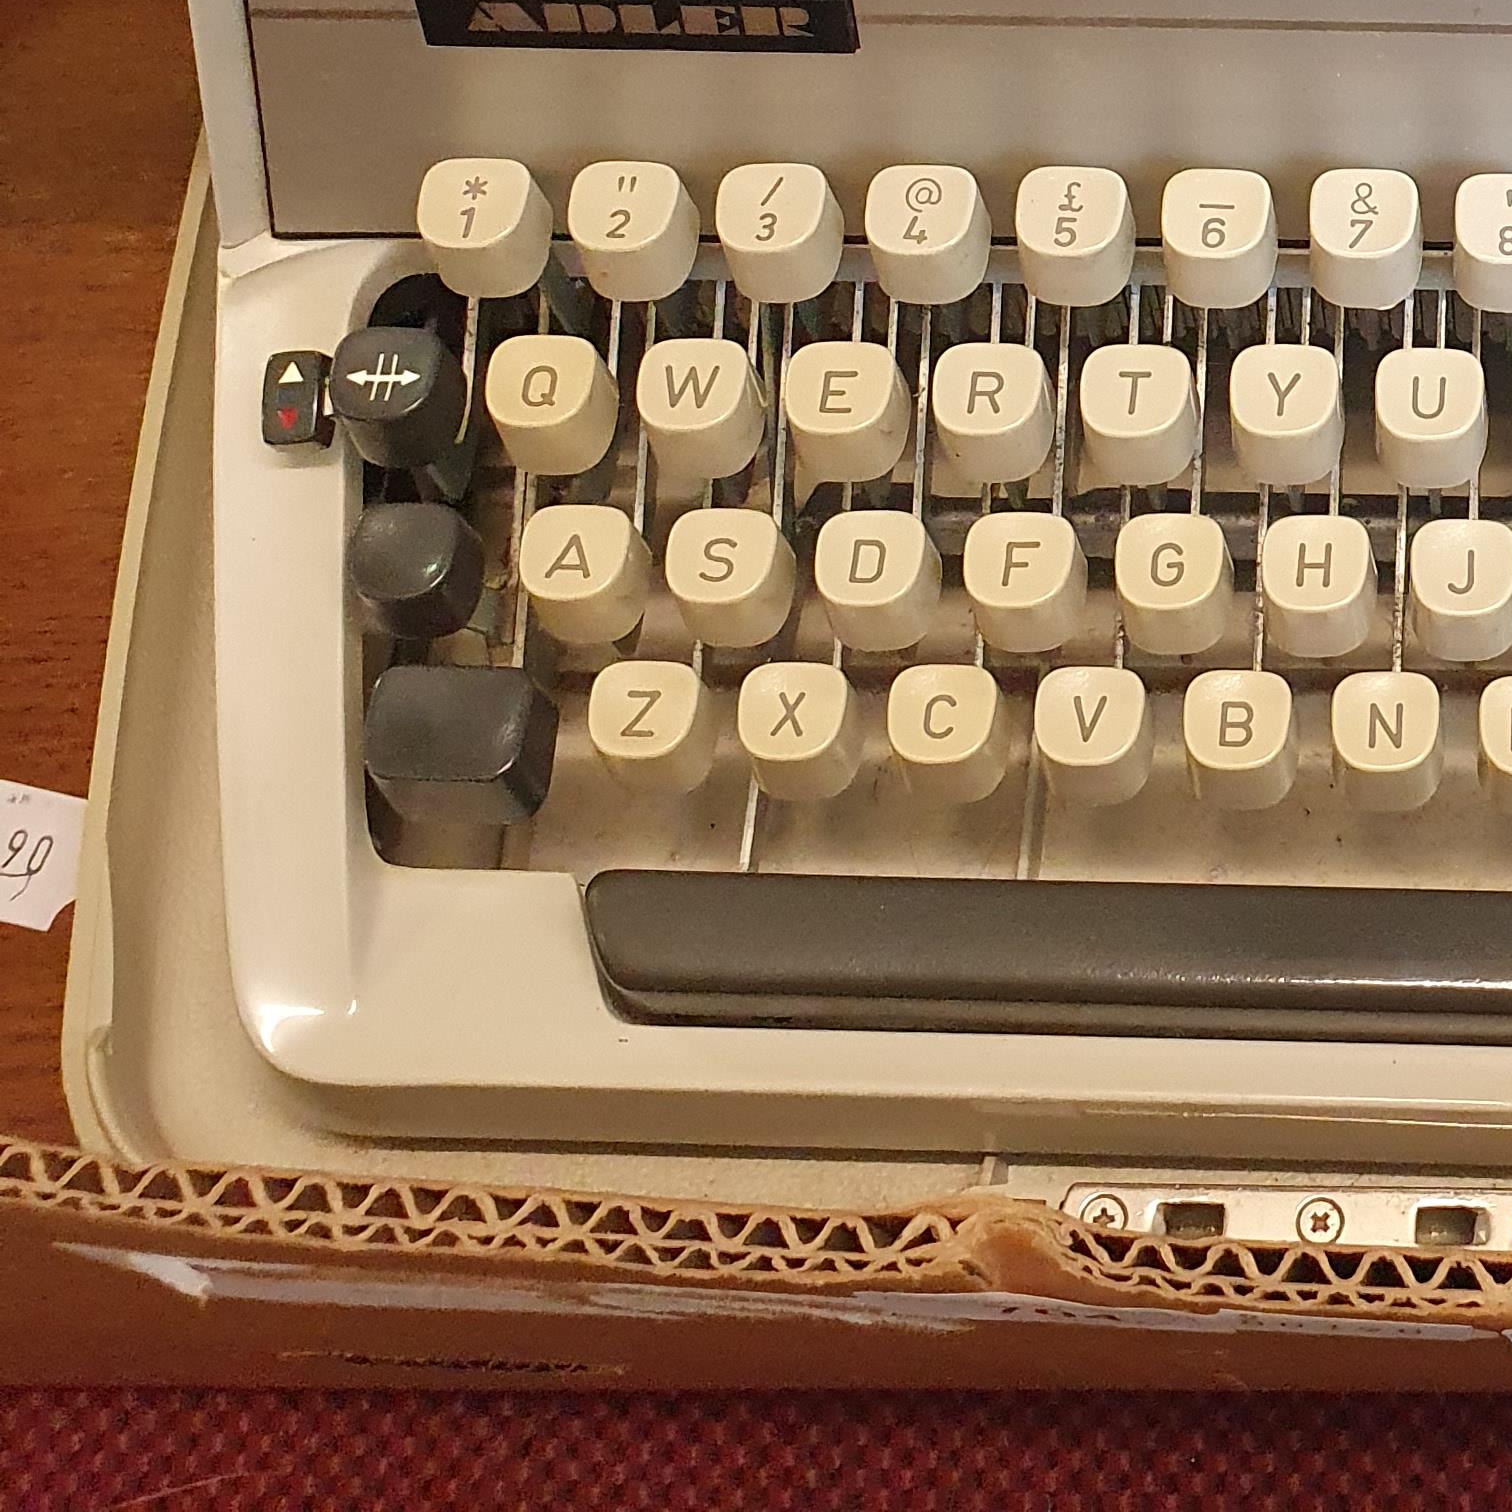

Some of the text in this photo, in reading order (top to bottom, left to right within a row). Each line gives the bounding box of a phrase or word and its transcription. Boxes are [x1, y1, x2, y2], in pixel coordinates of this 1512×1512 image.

[467, 1, 814, 37] ADLER
[760, 176, 784, 207] /
[905, 177, 943, 213] @
[1057, 181, 1084, 213] £
[1350, 182, 1379, 216] &
[459, 206, 476, 239] 1
[605, 209, 631, 239] 2
[754, 212, 778, 242] 3
[902, 215, 928, 245] 4
[1053, 216, 1078, 248] 5
[1201, 217, 1226, 249] 6
[1348, 218, 1374, 250] 7
[521, 365, 558, 408] Q
[664, 364, 721, 410] W
[818, 370, 859, 414] E
[966, 370, 1005, 415] R
[1118, 370, 1153, 416] T
[1267, 371, 1302, 417] Y
[1411, 375, 1447, 420] U
[544, 533, 591, 580] A
[698, 537, 738, 583] S
[848, 539, 887, 584] D
[1001, 541, 1041, 587] F
[1150, 542, 1185, 588] G
[1295, 542, 1333, 588] H
[1447, 549, 1475, 595] J
[619, 689, 662, 738] Z
[769, 691, 806, 738] X
[923, 694, 958, 740] C
[1073, 695, 1108, 743] V
[1218, 701, 1254, 748] B
[1368, 702, 1404, 750] N
